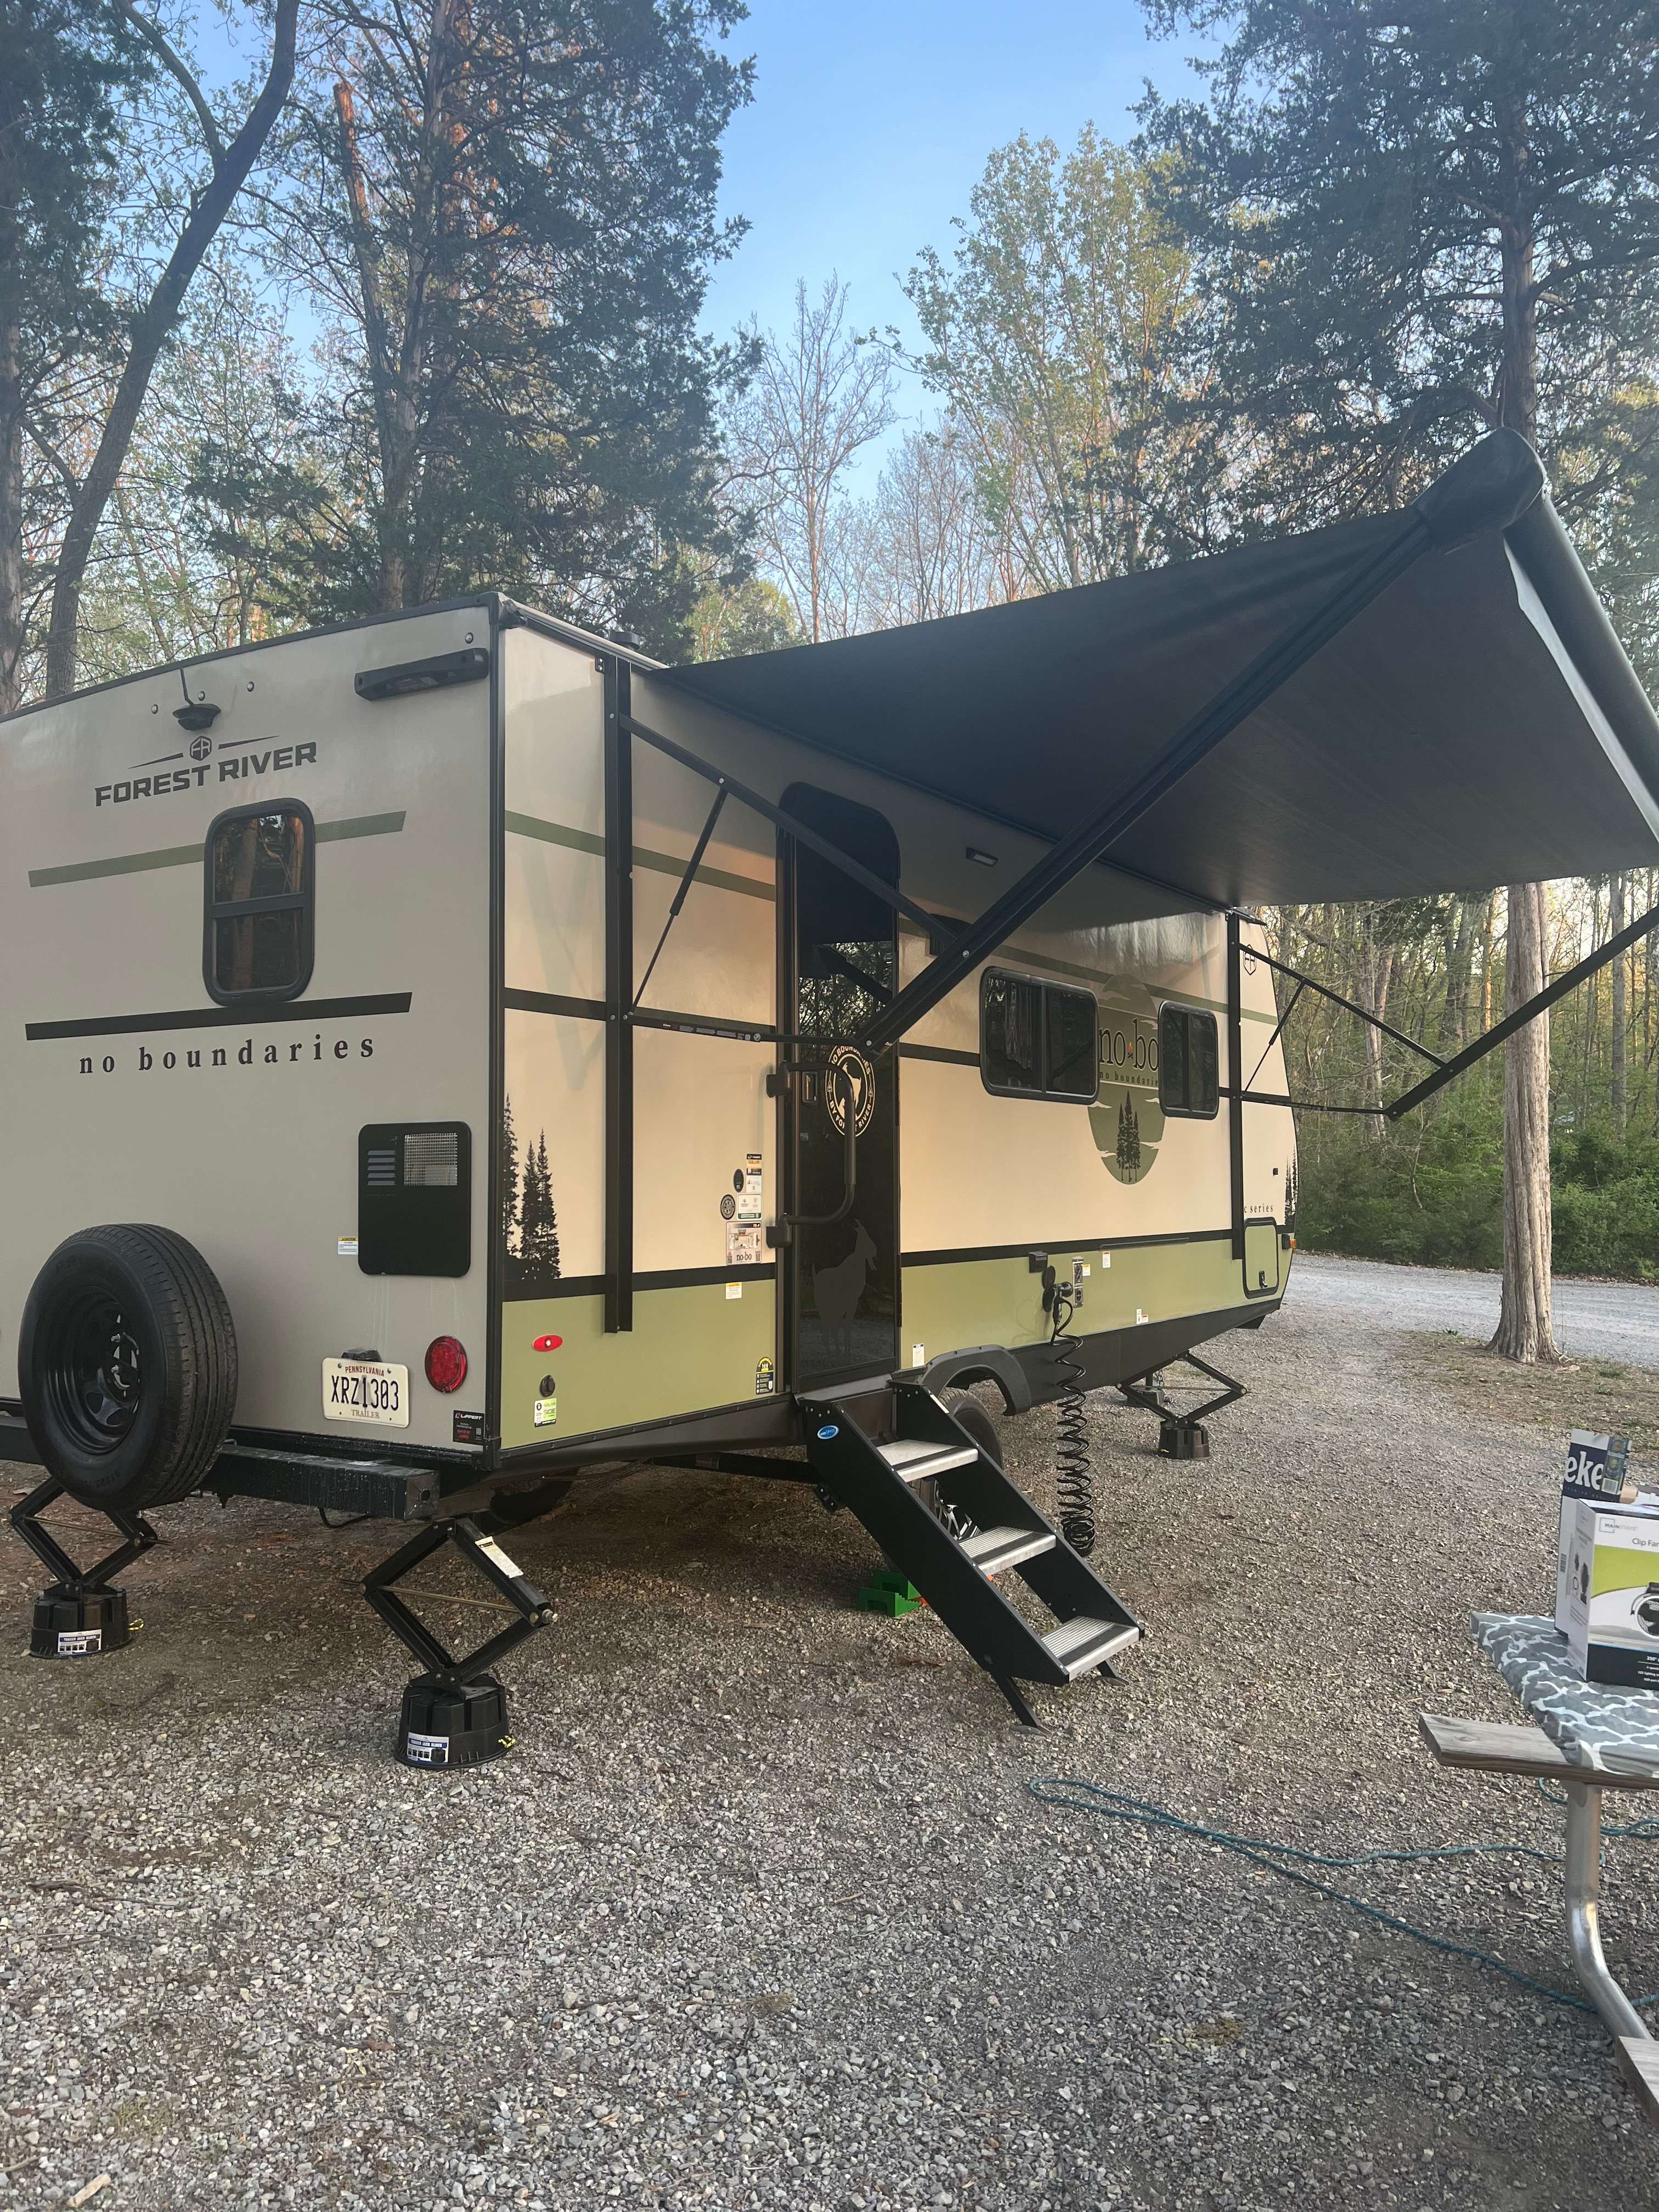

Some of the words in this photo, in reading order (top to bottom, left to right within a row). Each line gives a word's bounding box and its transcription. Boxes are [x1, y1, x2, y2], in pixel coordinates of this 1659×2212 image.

[94, 764, 211, 806] FOREST
[218, 741, 317, 782] RIVER
[80, 1054, 115, 1074] no
[138, 1034, 374, 1071] boundaries
[1115, 1071, 1159, 1086] boundarie
[830, 1101, 837, 1114] BY
[859, 1104, 871, 1128] RIVER
[1250, 1203, 1273, 1213] series
[345, 1365, 385, 1376] PENNSYLVANIA
[331, 1375, 399, 1411] XRZ1303
[351, 1409, 380, 1419] TRAILER
[1632, 1538, 1646, 1547] Clip
